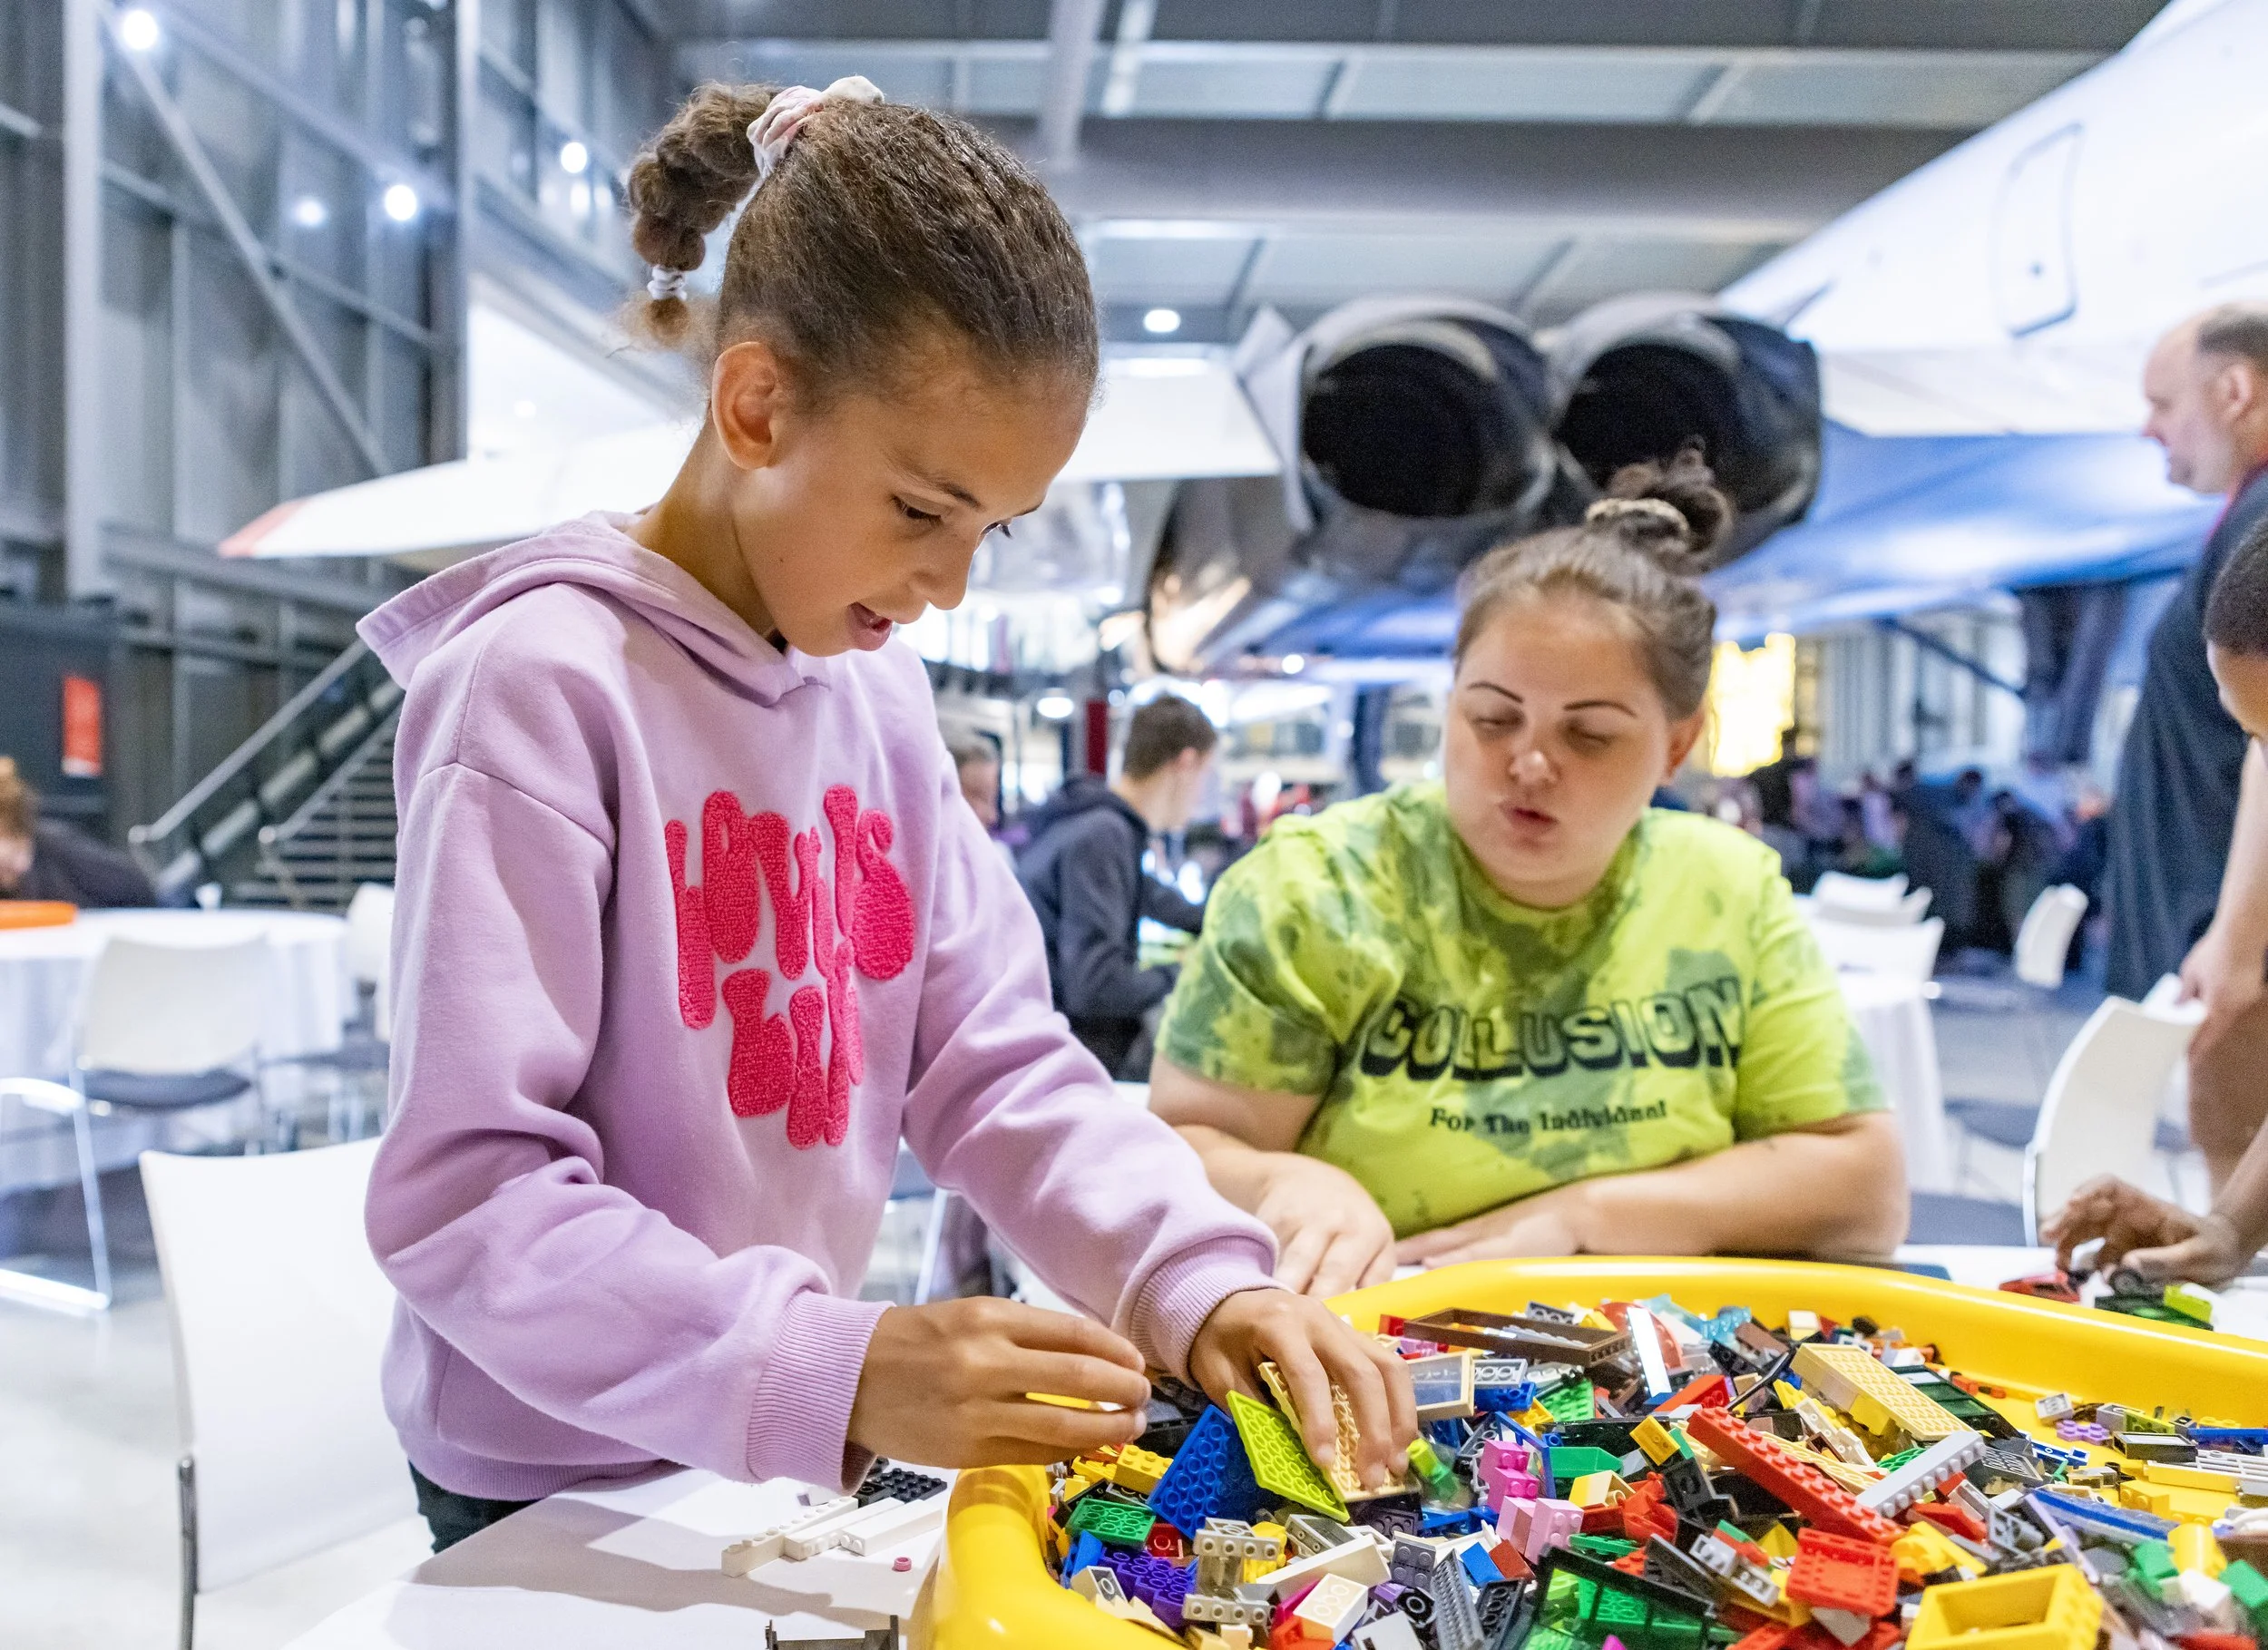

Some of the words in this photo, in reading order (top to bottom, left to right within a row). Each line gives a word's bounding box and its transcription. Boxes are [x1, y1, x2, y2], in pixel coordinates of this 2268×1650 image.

[1360, 977, 1745, 1081] COLLUSION
[1429, 1107, 1476, 1132] For
[1483, 1113, 1531, 1135] The
